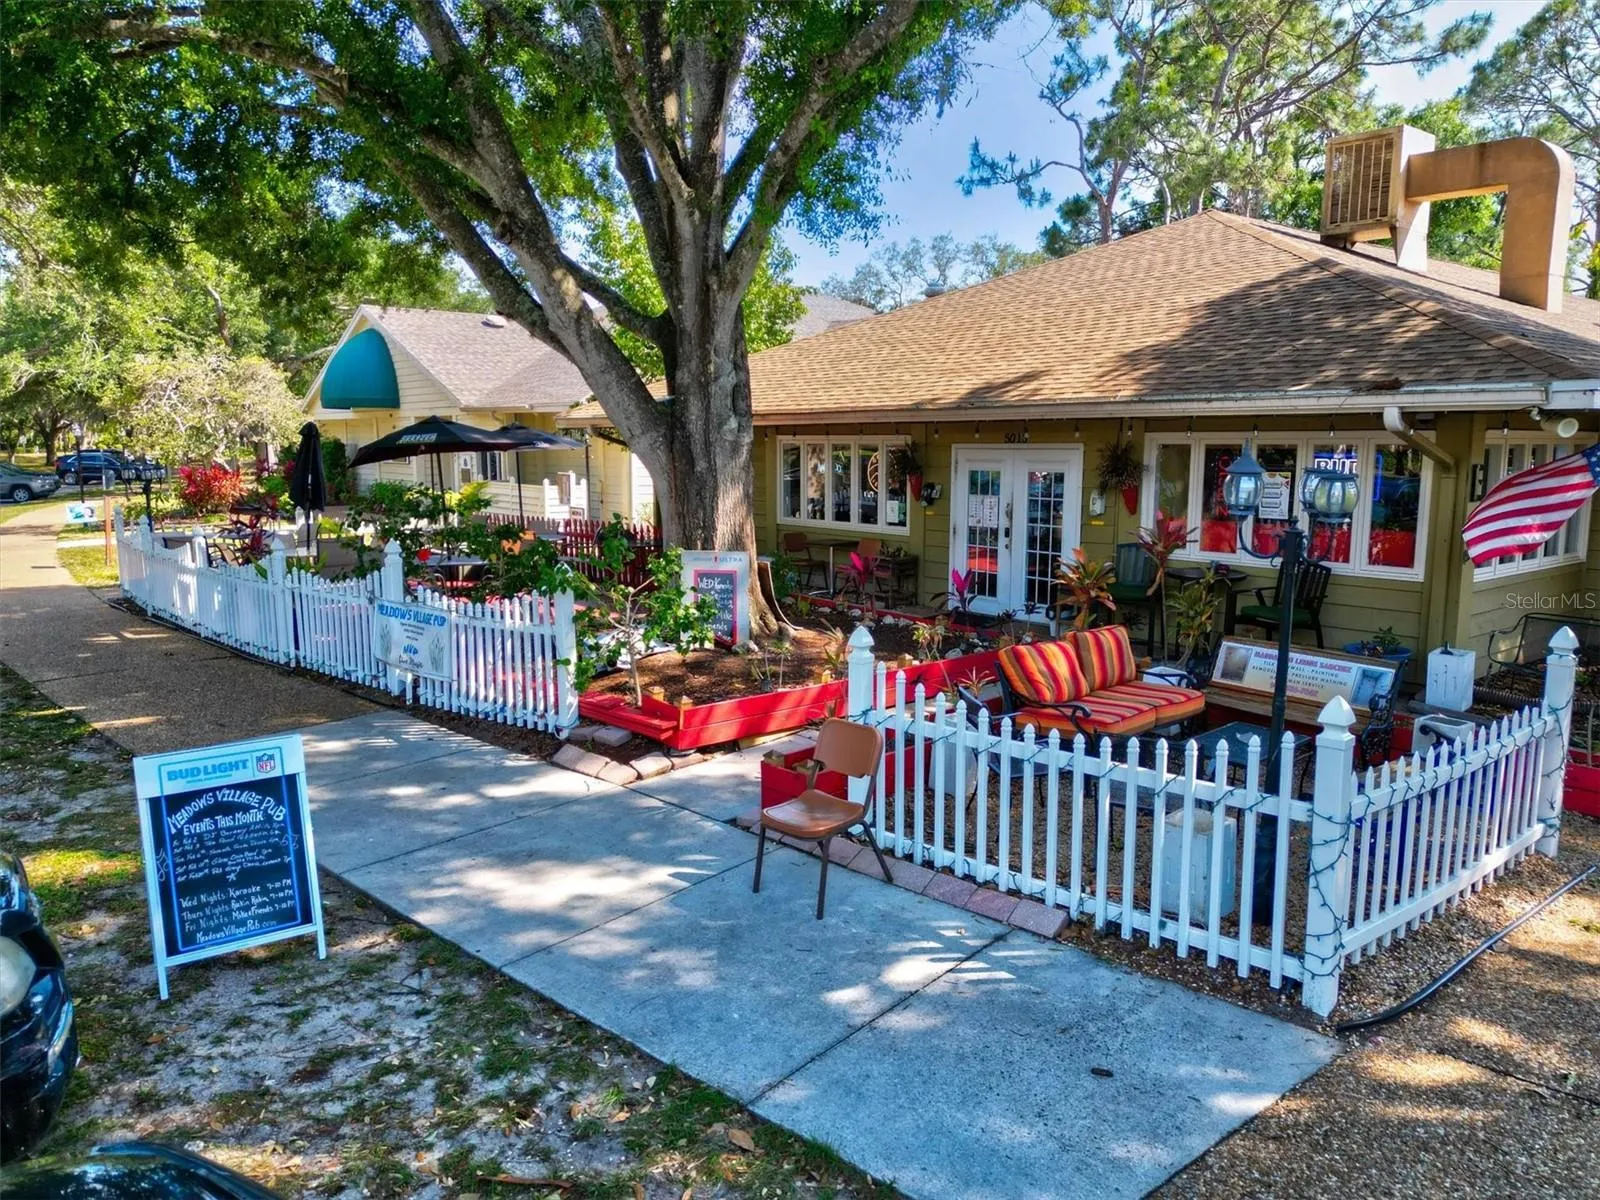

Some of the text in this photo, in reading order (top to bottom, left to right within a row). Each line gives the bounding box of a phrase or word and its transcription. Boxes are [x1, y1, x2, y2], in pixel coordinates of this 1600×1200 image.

[167, 768, 202, 781] BUD
[203, 759, 249, 776] LIGHT
[258, 761, 274, 770] NFL
[167, 788, 286, 834] MEADOWS VILLAGE PUB
[183, 818, 215, 835] EVENTS
[215, 815, 234, 829] THIS
[235, 809, 264, 825] MONTH
[180, 898, 198, 909] Wed
[282, 878, 292, 887] PM
[182, 911, 203, 921] Thurs
[285, 889, 294, 897] PM
[185, 922, 196, 932] Fri
